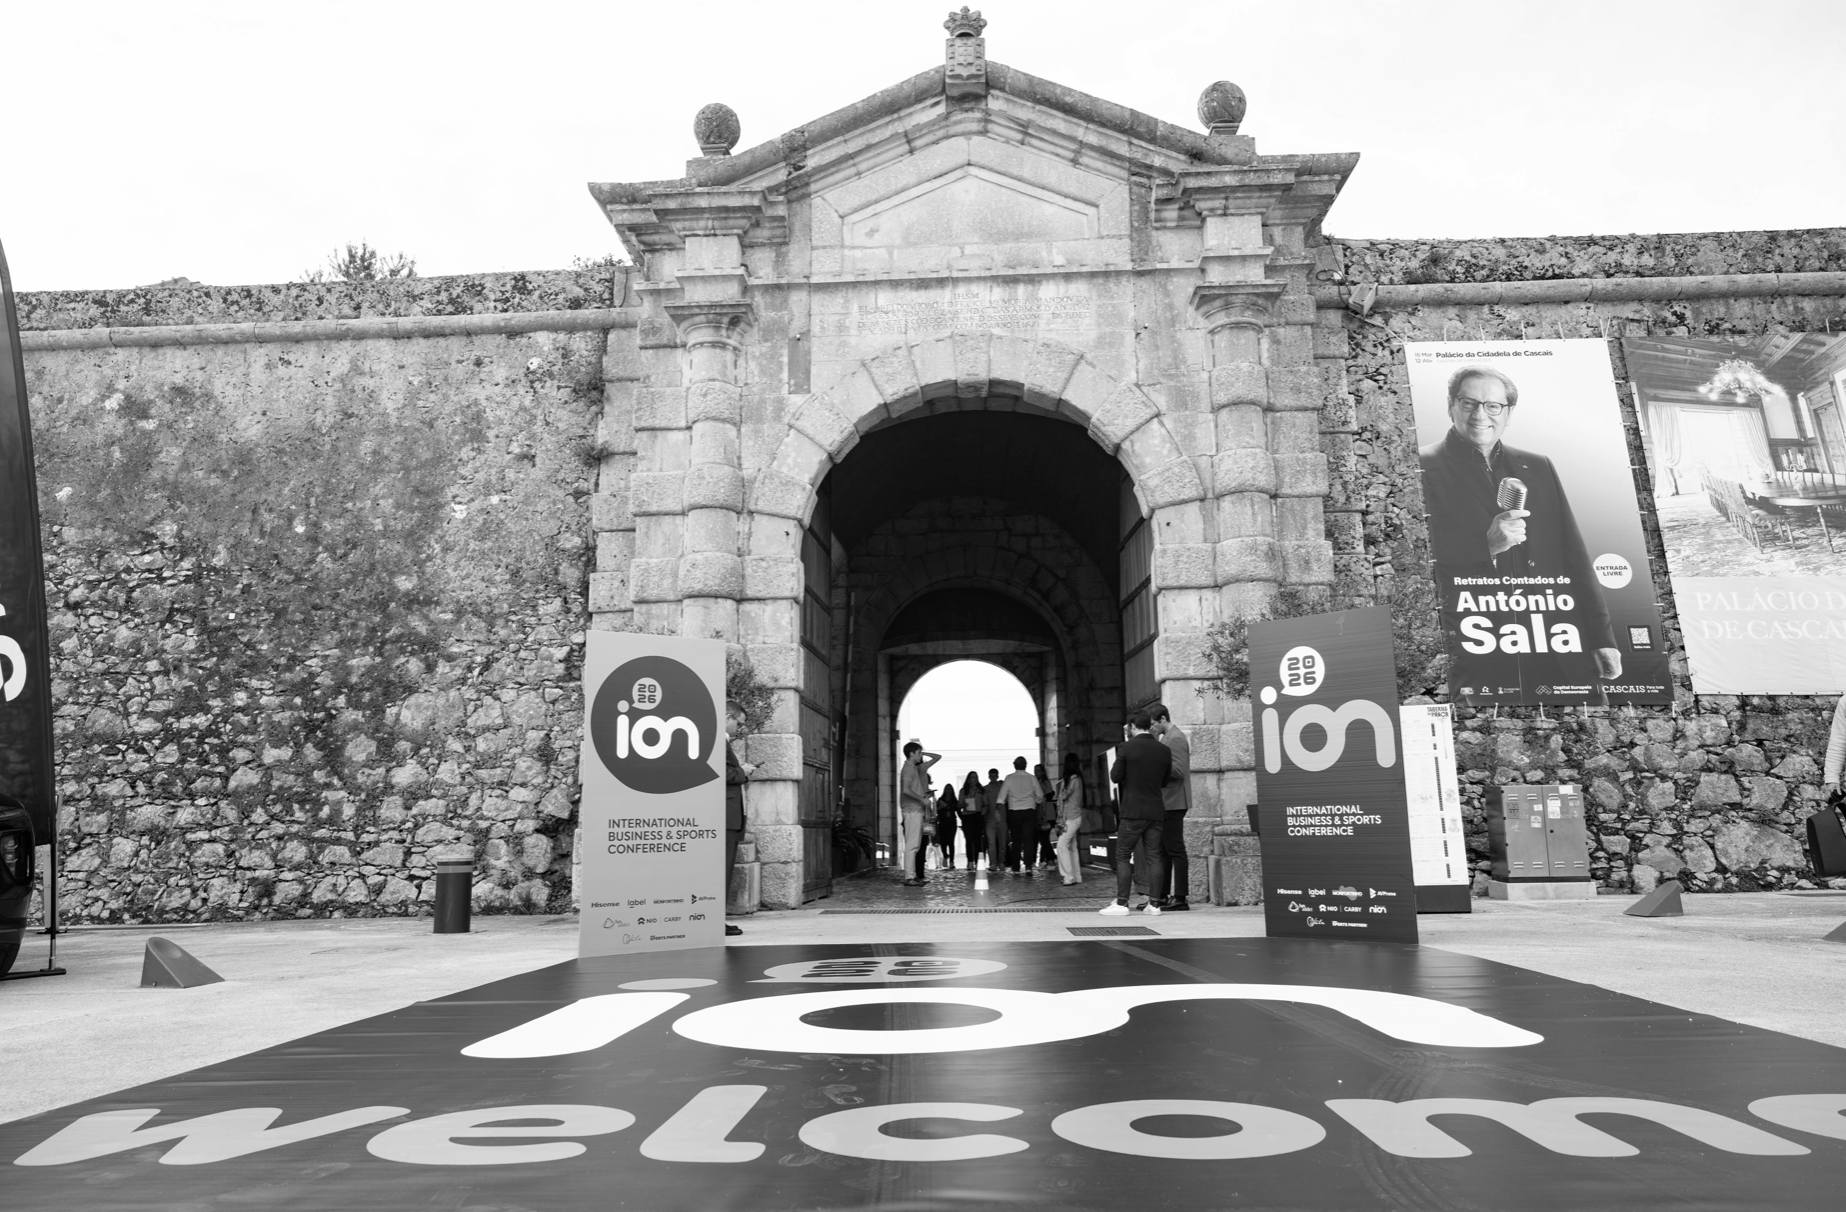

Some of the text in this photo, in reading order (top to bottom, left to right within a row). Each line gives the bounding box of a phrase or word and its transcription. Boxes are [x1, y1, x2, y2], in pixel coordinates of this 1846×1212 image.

[1454, 576, 1571, 585] Retratos Contados de
[1456, 589, 1575, 612] António
[1694, 586, 1819, 611] PALÁCIO
[1460, 613, 1583, 655] Sala
[1701, 619, 1846, 640] DE CASCA
[1287, 655, 1316, 671] 20
[1288, 671, 1316, 687] 26
[638, 684, 656, 693] 20
[1602, 685, 1646, 693] CASCAIS
[638, 694, 656, 704] 26
[616, 700, 700, 760] ion
[1260, 686, 1396, 774] ion
[1286, 804, 1364, 815] INTERNATIONAL
[608, 817, 699, 829] INTERNATIONAL
[1287, 815, 1382, 826] BUSINESS & SPORTS
[608, 829, 717, 842] BUSINESS & SPORTS
[1288, 826, 1354, 836] CONFERENCE
[608, 842, 686, 854] CONFERENCE
[627, 899, 646, 908] label
[461, 978, 1545, 1058] ion
